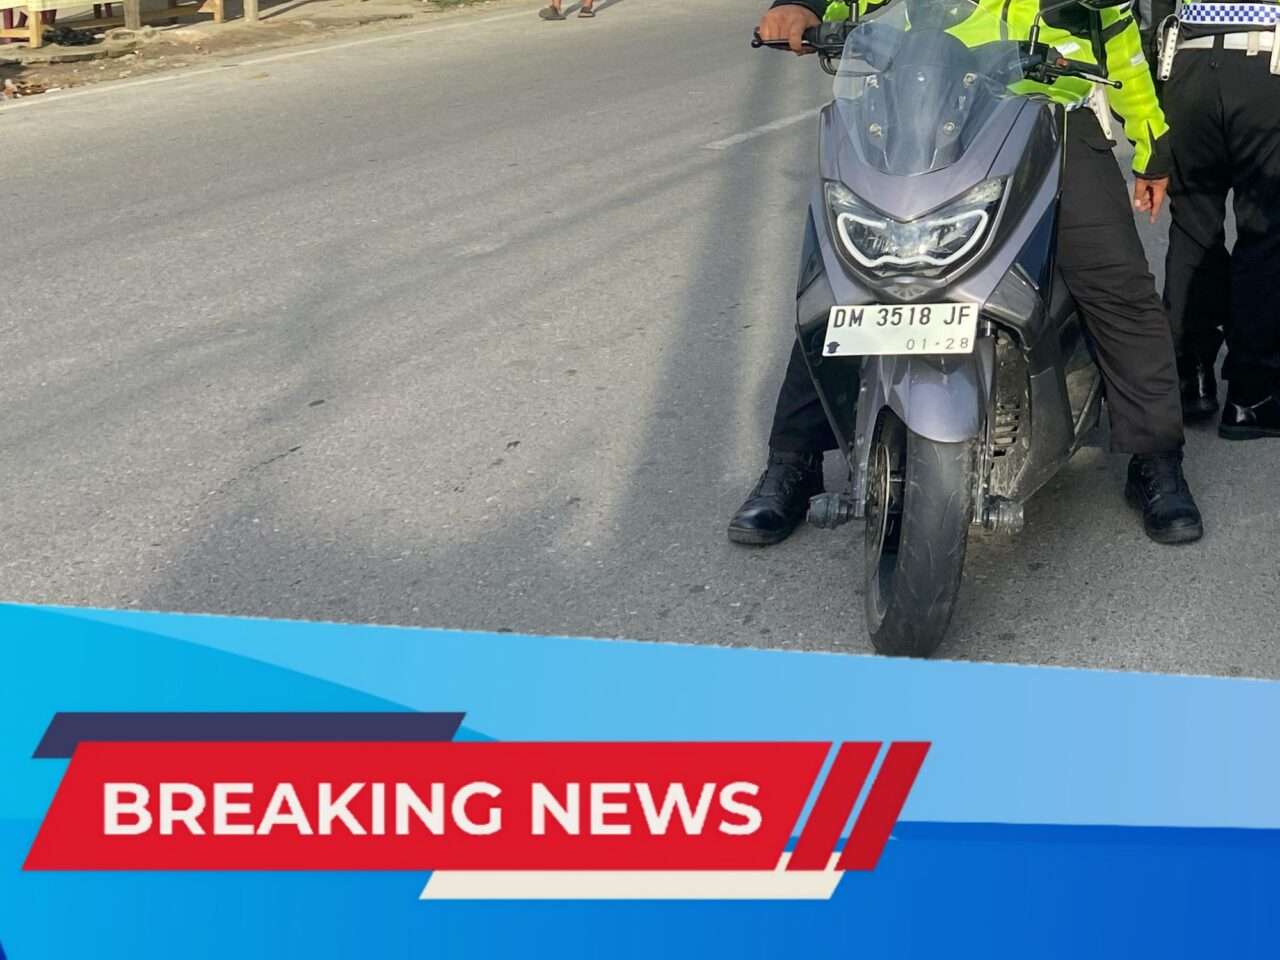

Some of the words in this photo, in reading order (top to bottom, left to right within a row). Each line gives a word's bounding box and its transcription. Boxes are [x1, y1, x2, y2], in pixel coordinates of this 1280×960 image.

[833, 308, 864, 328] DM
[876, 307, 932, 326] 3518
[943, 305, 971, 325] JF
